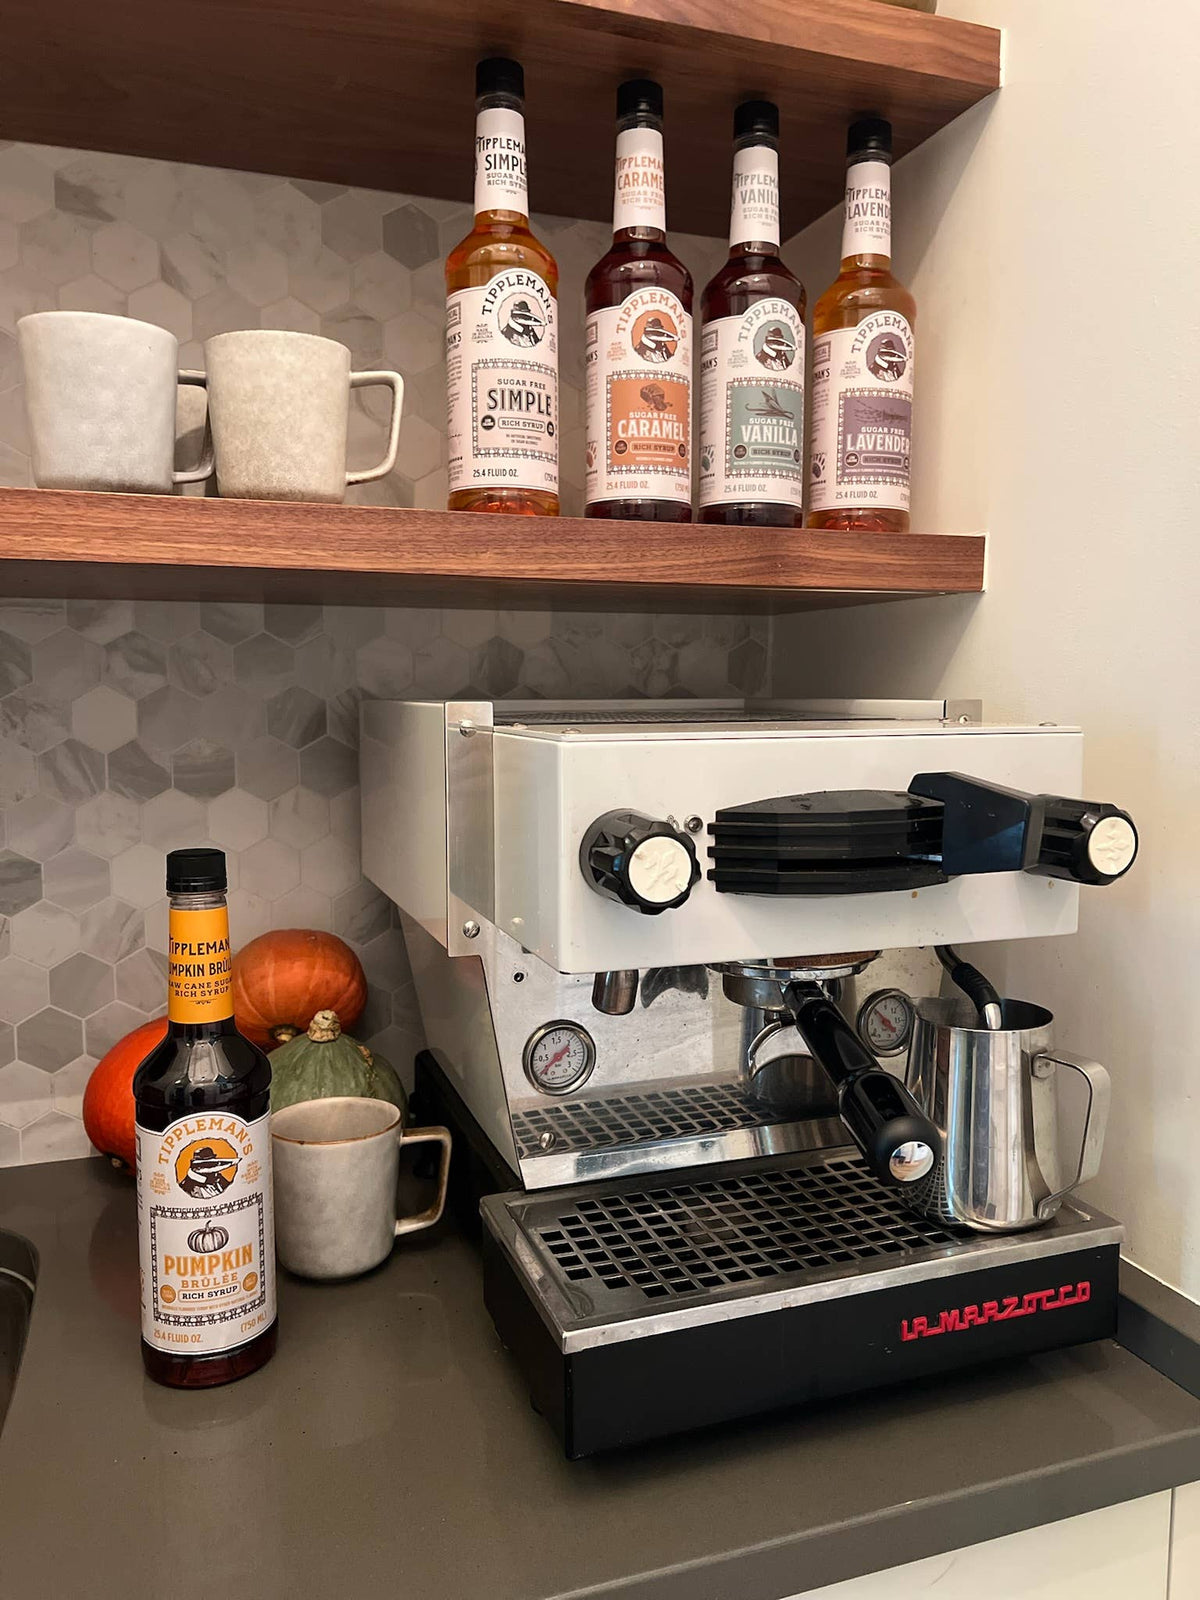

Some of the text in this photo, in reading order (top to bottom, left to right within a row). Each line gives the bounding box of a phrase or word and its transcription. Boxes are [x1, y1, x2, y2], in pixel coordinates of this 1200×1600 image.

[487, 172, 513, 180] SUGAR
[487, 179, 507, 187] RICH
[482, 274, 554, 324] TIPPLEMAN'S
[616, 292, 688, 339] TIPPLEMAN'S
[738, 303, 803, 349] TIPPLEMAN'S
[851, 316, 913, 359] TIPPLEMAN'S
[497, 378, 546, 391] SUGAR FREE
[487, 388, 553, 416] SIMPLE
[629, 411, 658, 419] SUGAR
[522, 420, 544, 430] SYRUP
[749, 417, 794, 428] SUGAR FREE
[617, 419, 685, 441] CARAMEL
[740, 425, 798, 446] VANILLA
[890, 428, 905, 436] FREE
[633, 443, 652, 451] RICH
[654, 444, 675, 452] SYRUP
[846, 433, 910, 453] LAVENDER
[473, 469, 519, 478] 25.4 FLUID OZ.
[620, 481, 638, 489] FLUID
[738, 484, 756, 492] FLUID
[184, 981, 212, 990] CANE
[175, 989, 197, 998] RICH
[158, 1118, 254, 1165] TIPPLEMAN'S
[163, 1242, 253, 1277] PUMPKIN
[207, 1285, 239, 1298] SYRUP
[901, 1281, 1091, 1342] LA MARZOCCO
[240, 1310, 267, 1333] (750 ML)
[167, 1333, 189, 1343] FLUID
[190, 1333, 203, 1343] OZ.
